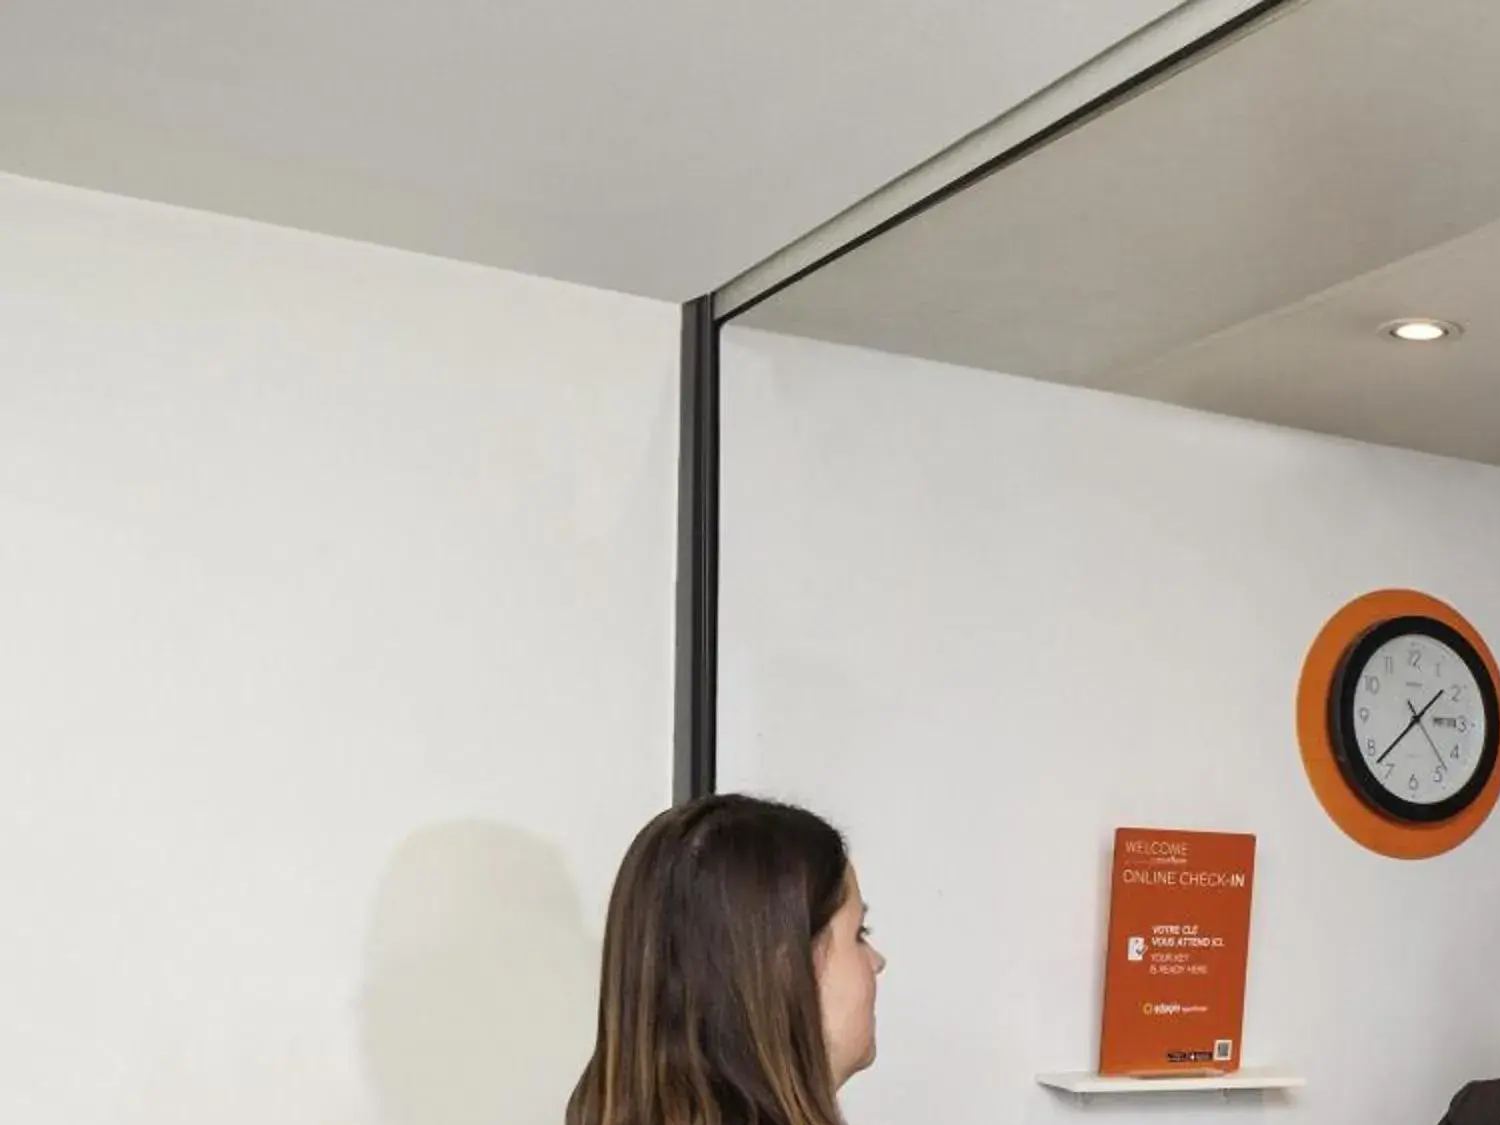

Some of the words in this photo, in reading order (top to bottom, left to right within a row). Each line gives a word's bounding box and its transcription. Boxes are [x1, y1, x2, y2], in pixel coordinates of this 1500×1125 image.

[1385, 656, 1394, 675] 11
[1364, 675, 1380, 695] 10
[1450, 684, 1462, 702] 2
[1359, 707, 1370, 724] 9
[1457, 716, 1468, 733] 3
[1367, 739, 1376, 756] 8
[1450, 744, 1460, 760] 4
[1384, 762, 1395, 779] 7
[1433, 765, 1445, 783] 5
[1408, 773, 1418, 790] 6
[1125, 841, 1188, 856] WELCOME
[1123, 869, 1177, 885] ONLINE
[1179, 872, 1245, 888] CHECK-IN
[1152, 925, 1180, 935] VOTRE
[1152, 937, 1174, 947] VOUS
[1177, 937, 1210, 947] ATTEND
